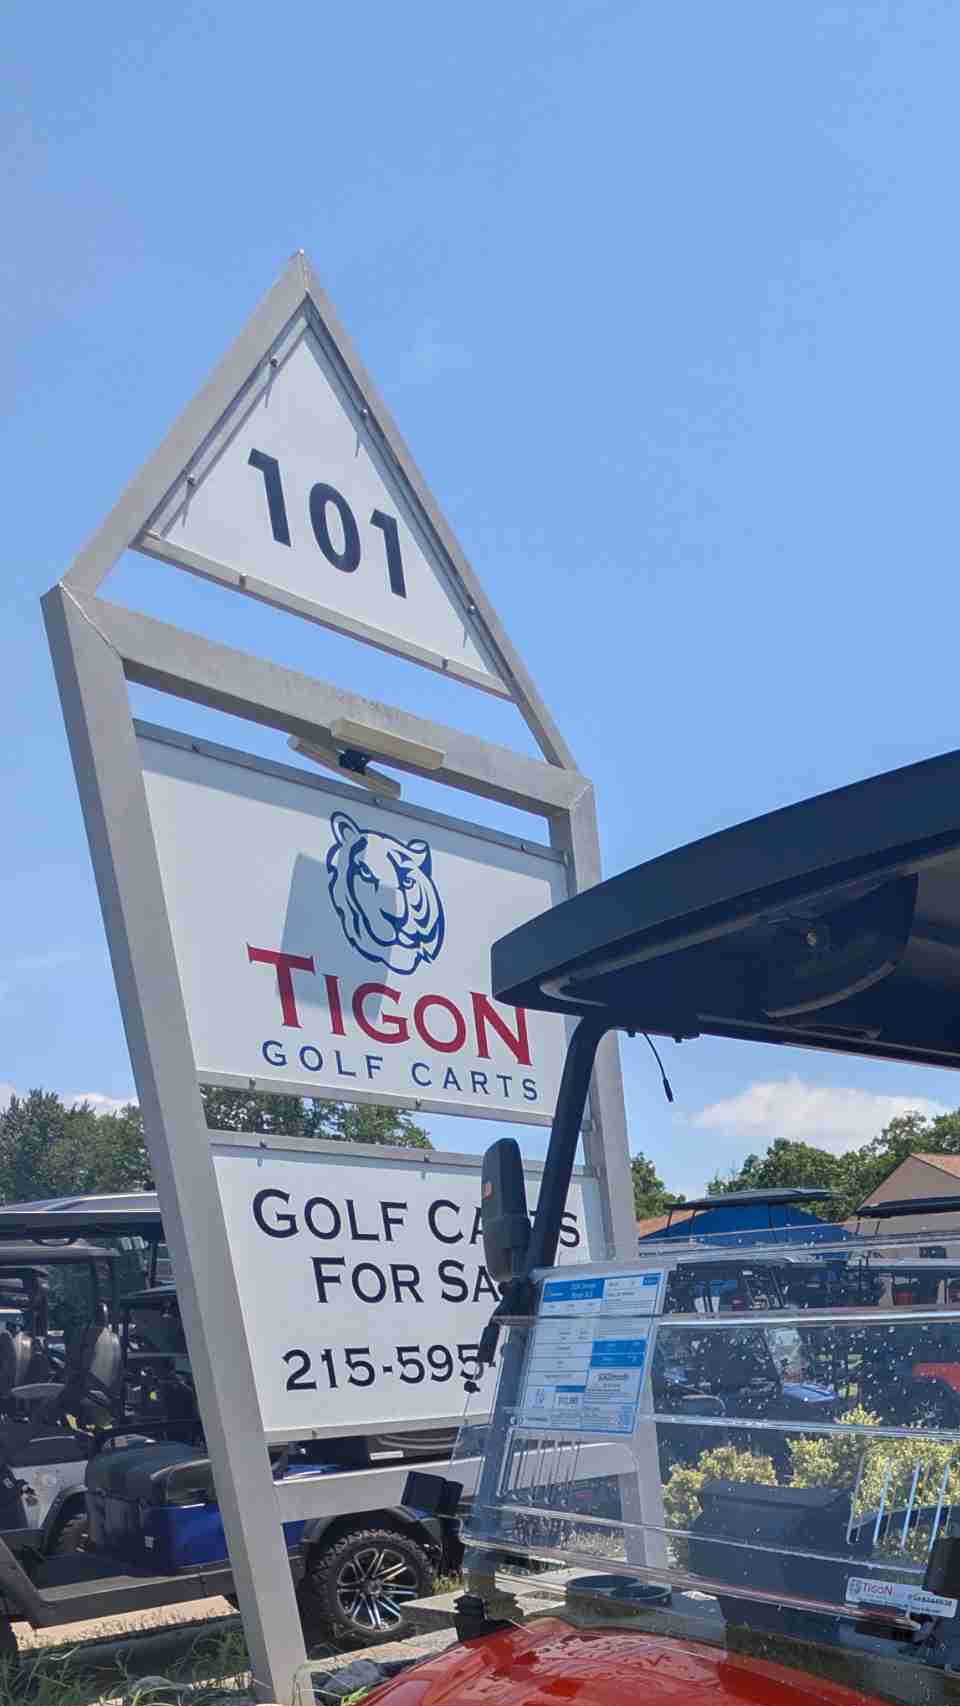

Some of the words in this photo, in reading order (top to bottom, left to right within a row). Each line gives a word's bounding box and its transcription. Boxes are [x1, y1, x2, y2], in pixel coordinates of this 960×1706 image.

[247, 448, 407, 599] 101
[247, 943, 533, 1066] TIGON
[261, 1039, 384, 1080] GOLF
[411, 1062, 539, 1101] CARTS
[252, 1188, 408, 1243] GOLF
[311, 1256, 425, 1304] FOR
[437, 1259, 502, 1304] SA
